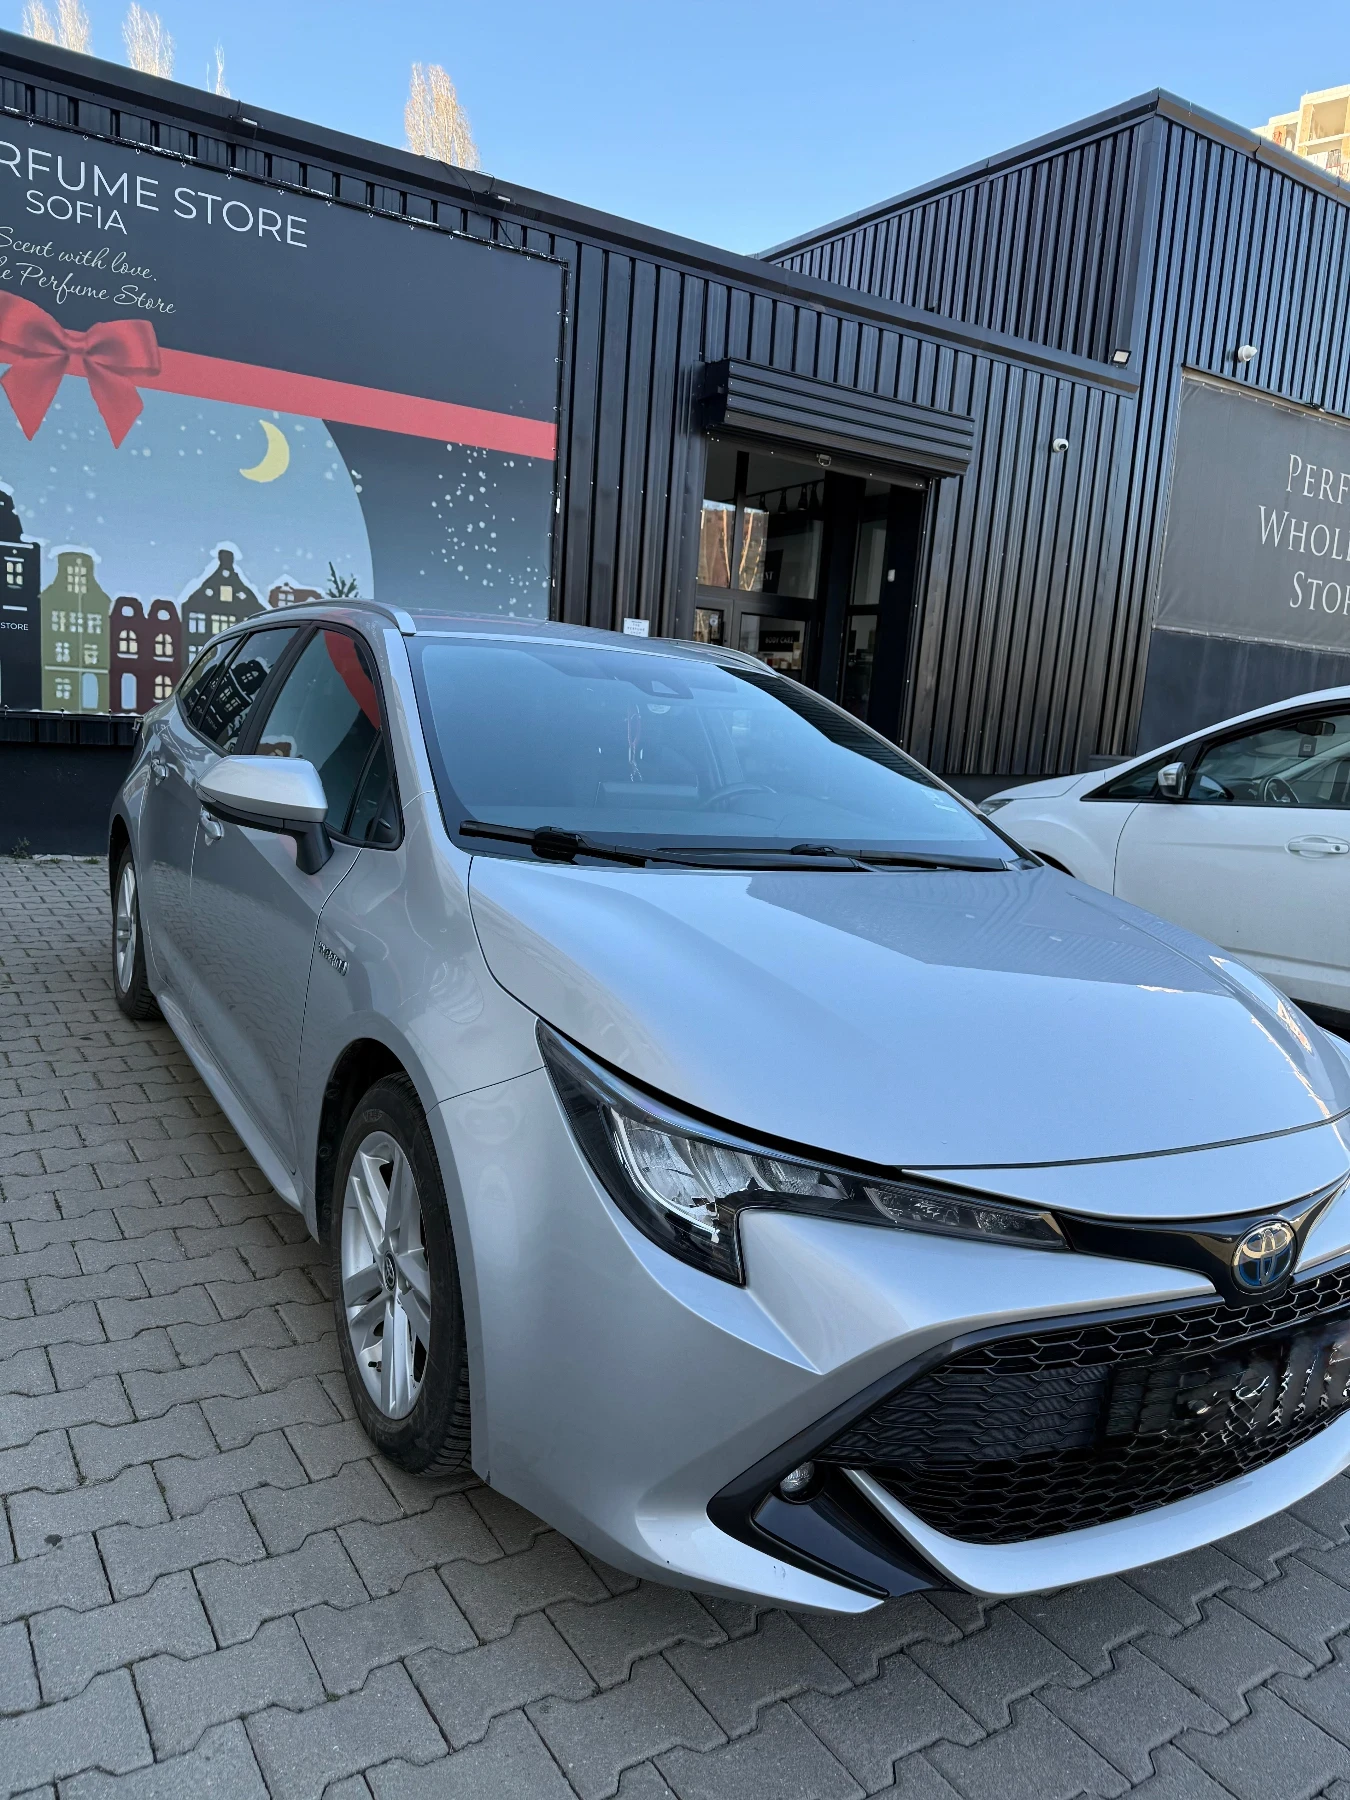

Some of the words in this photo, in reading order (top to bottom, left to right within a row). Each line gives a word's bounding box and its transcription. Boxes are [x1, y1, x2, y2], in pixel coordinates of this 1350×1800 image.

[26, 189, 128, 235] SOFIA
[173, 187, 308, 248] STORE
[0, 226, 54, 258] Scent
[58, 247, 107, 270] with
[111, 252, 157, 281] love.
[16, 262, 110, 304] Perfume
[113, 285, 176, 314] Store
[1286, 453, 1350, 504] PERF
[0, 621, 29, 631] STORE
